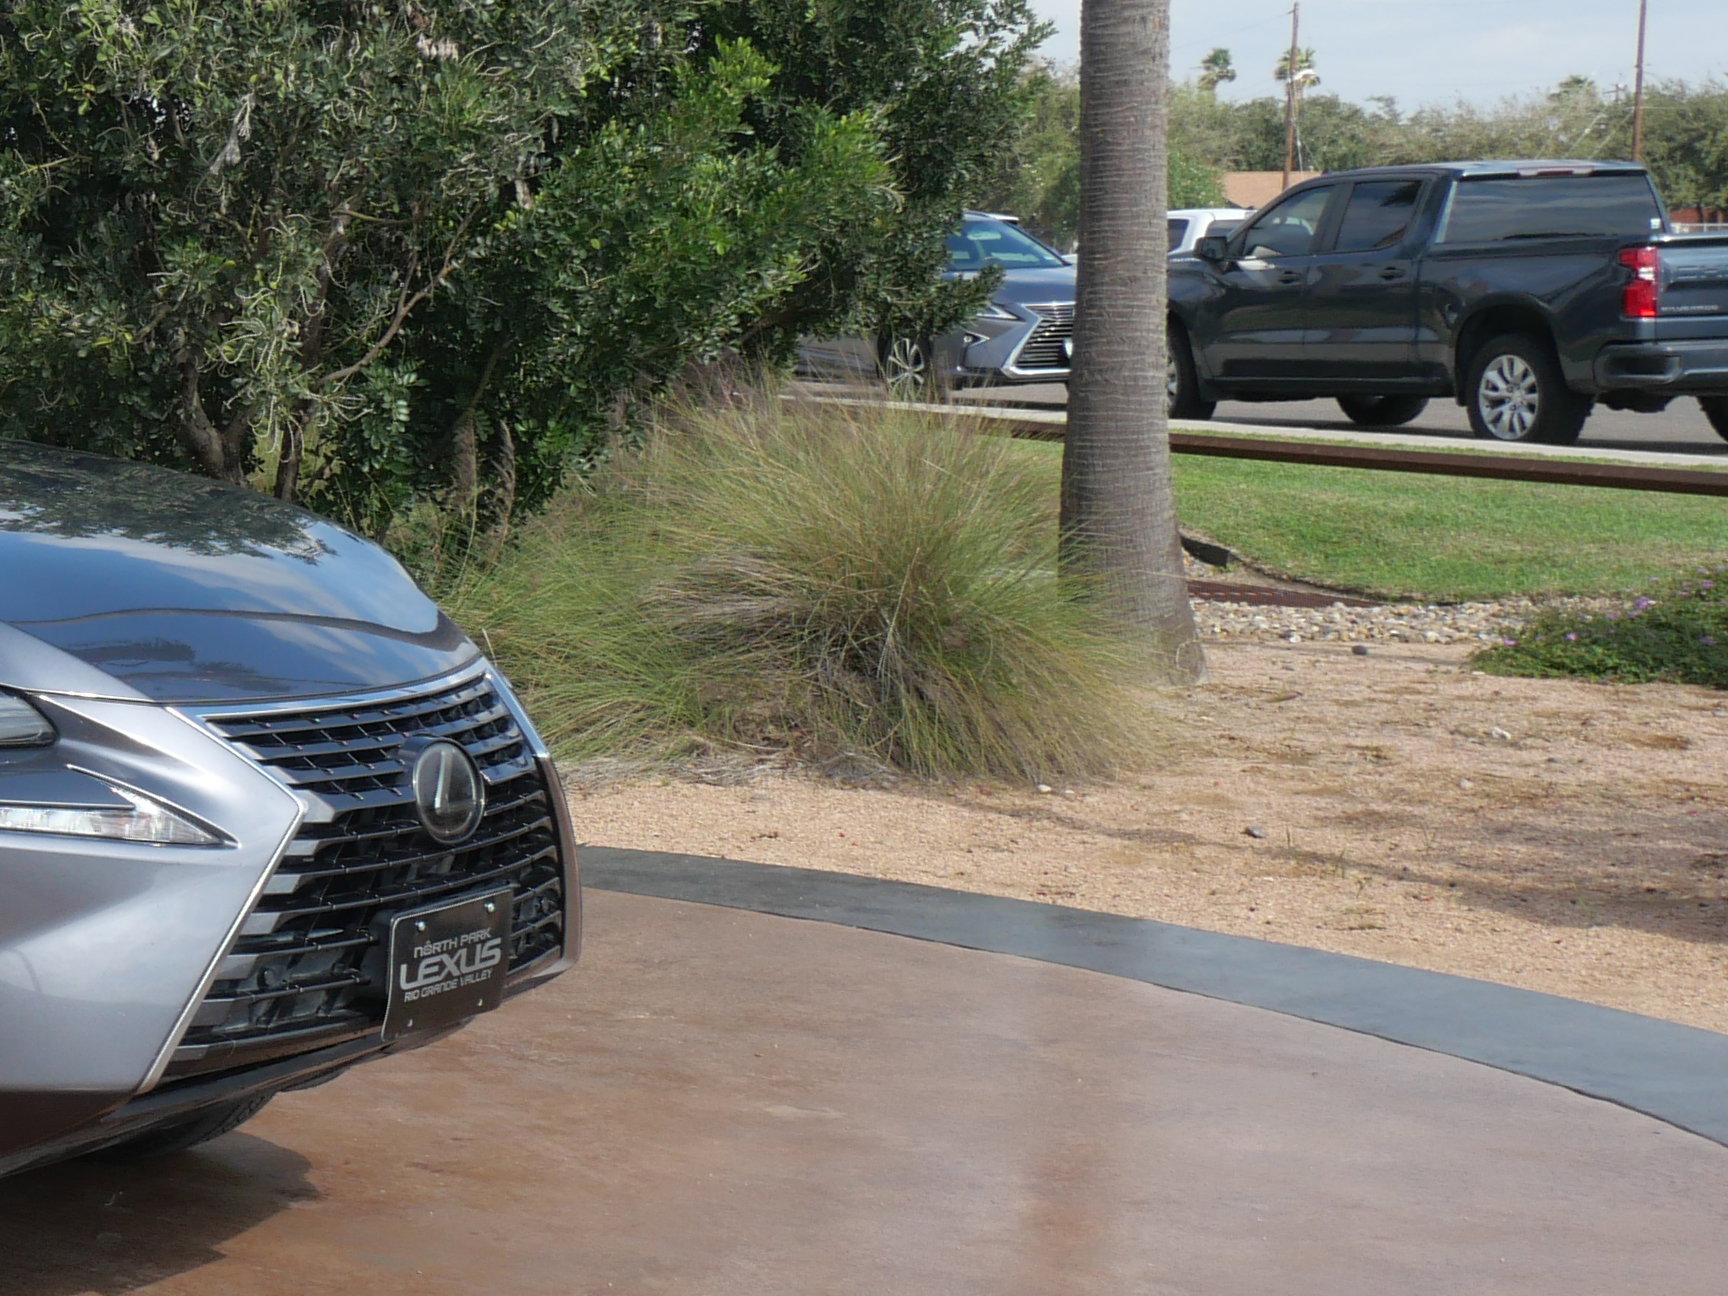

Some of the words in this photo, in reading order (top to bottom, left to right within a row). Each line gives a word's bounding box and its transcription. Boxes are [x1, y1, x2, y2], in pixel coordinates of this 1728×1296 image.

[414, 938, 458, 958] NORTH
[460, 928, 491, 946] PARK
[400, 937, 501, 990] LEXUS
[404, 989, 420, 1003] RIO
[421, 979, 458, 998] GRANDE
[460, 968, 493, 986] VALLEY
